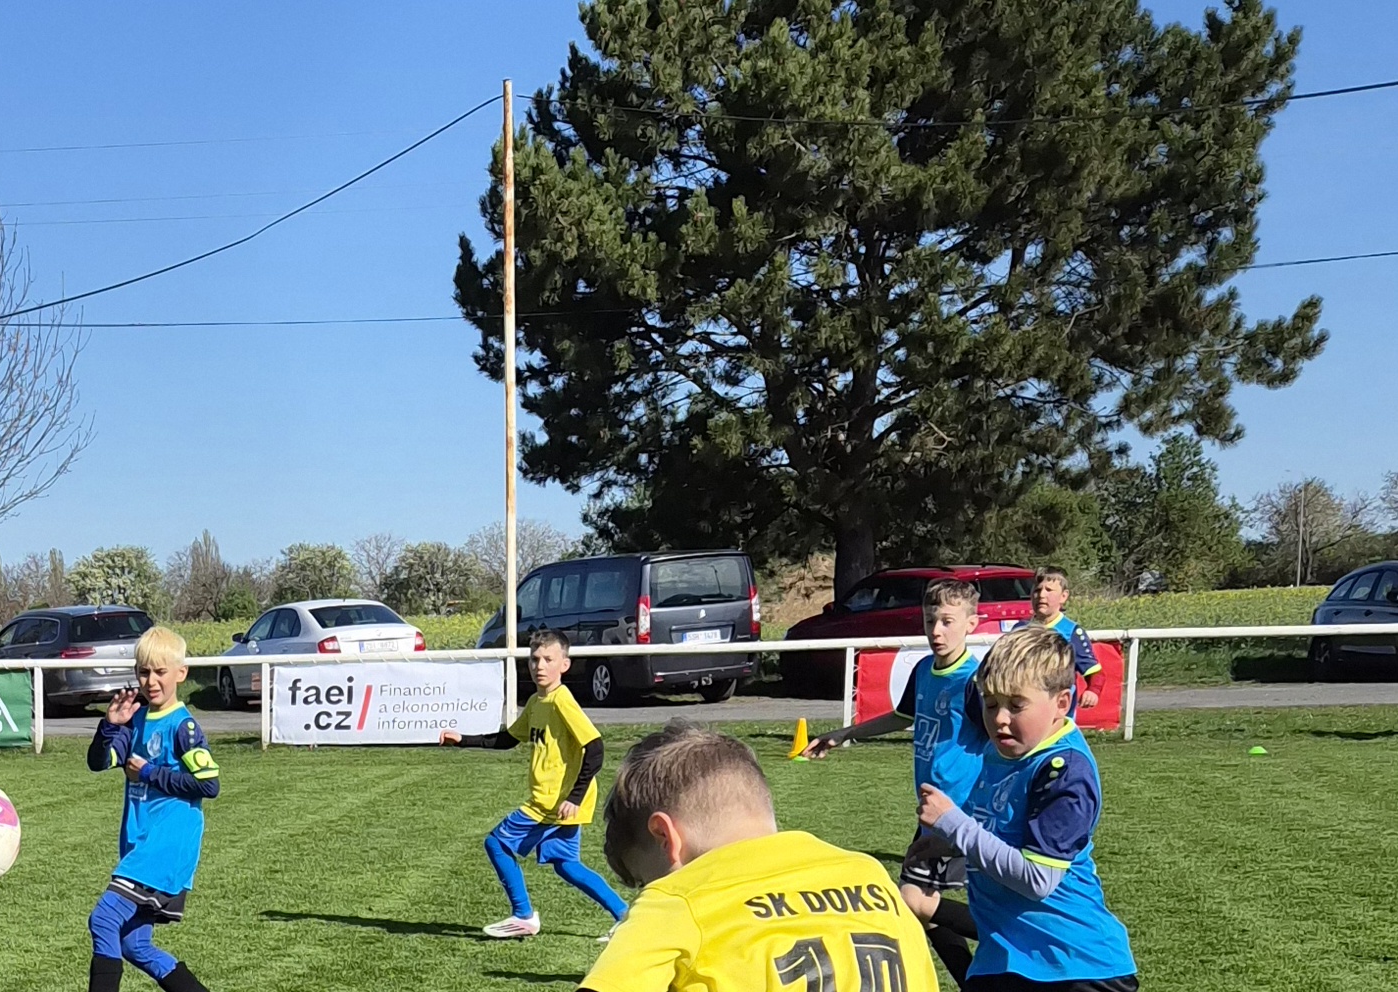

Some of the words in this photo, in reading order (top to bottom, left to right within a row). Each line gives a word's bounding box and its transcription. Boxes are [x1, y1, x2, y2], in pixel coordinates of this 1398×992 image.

[288, 675, 354, 705] faei
[379, 682, 447, 697] Finanční
[378, 703, 388, 713] a
[392, 698, 488, 714] ekonomické
[304, 709, 352, 731] .cz
[377, 717, 458, 731] informace
[744, 891, 800, 919] SK
